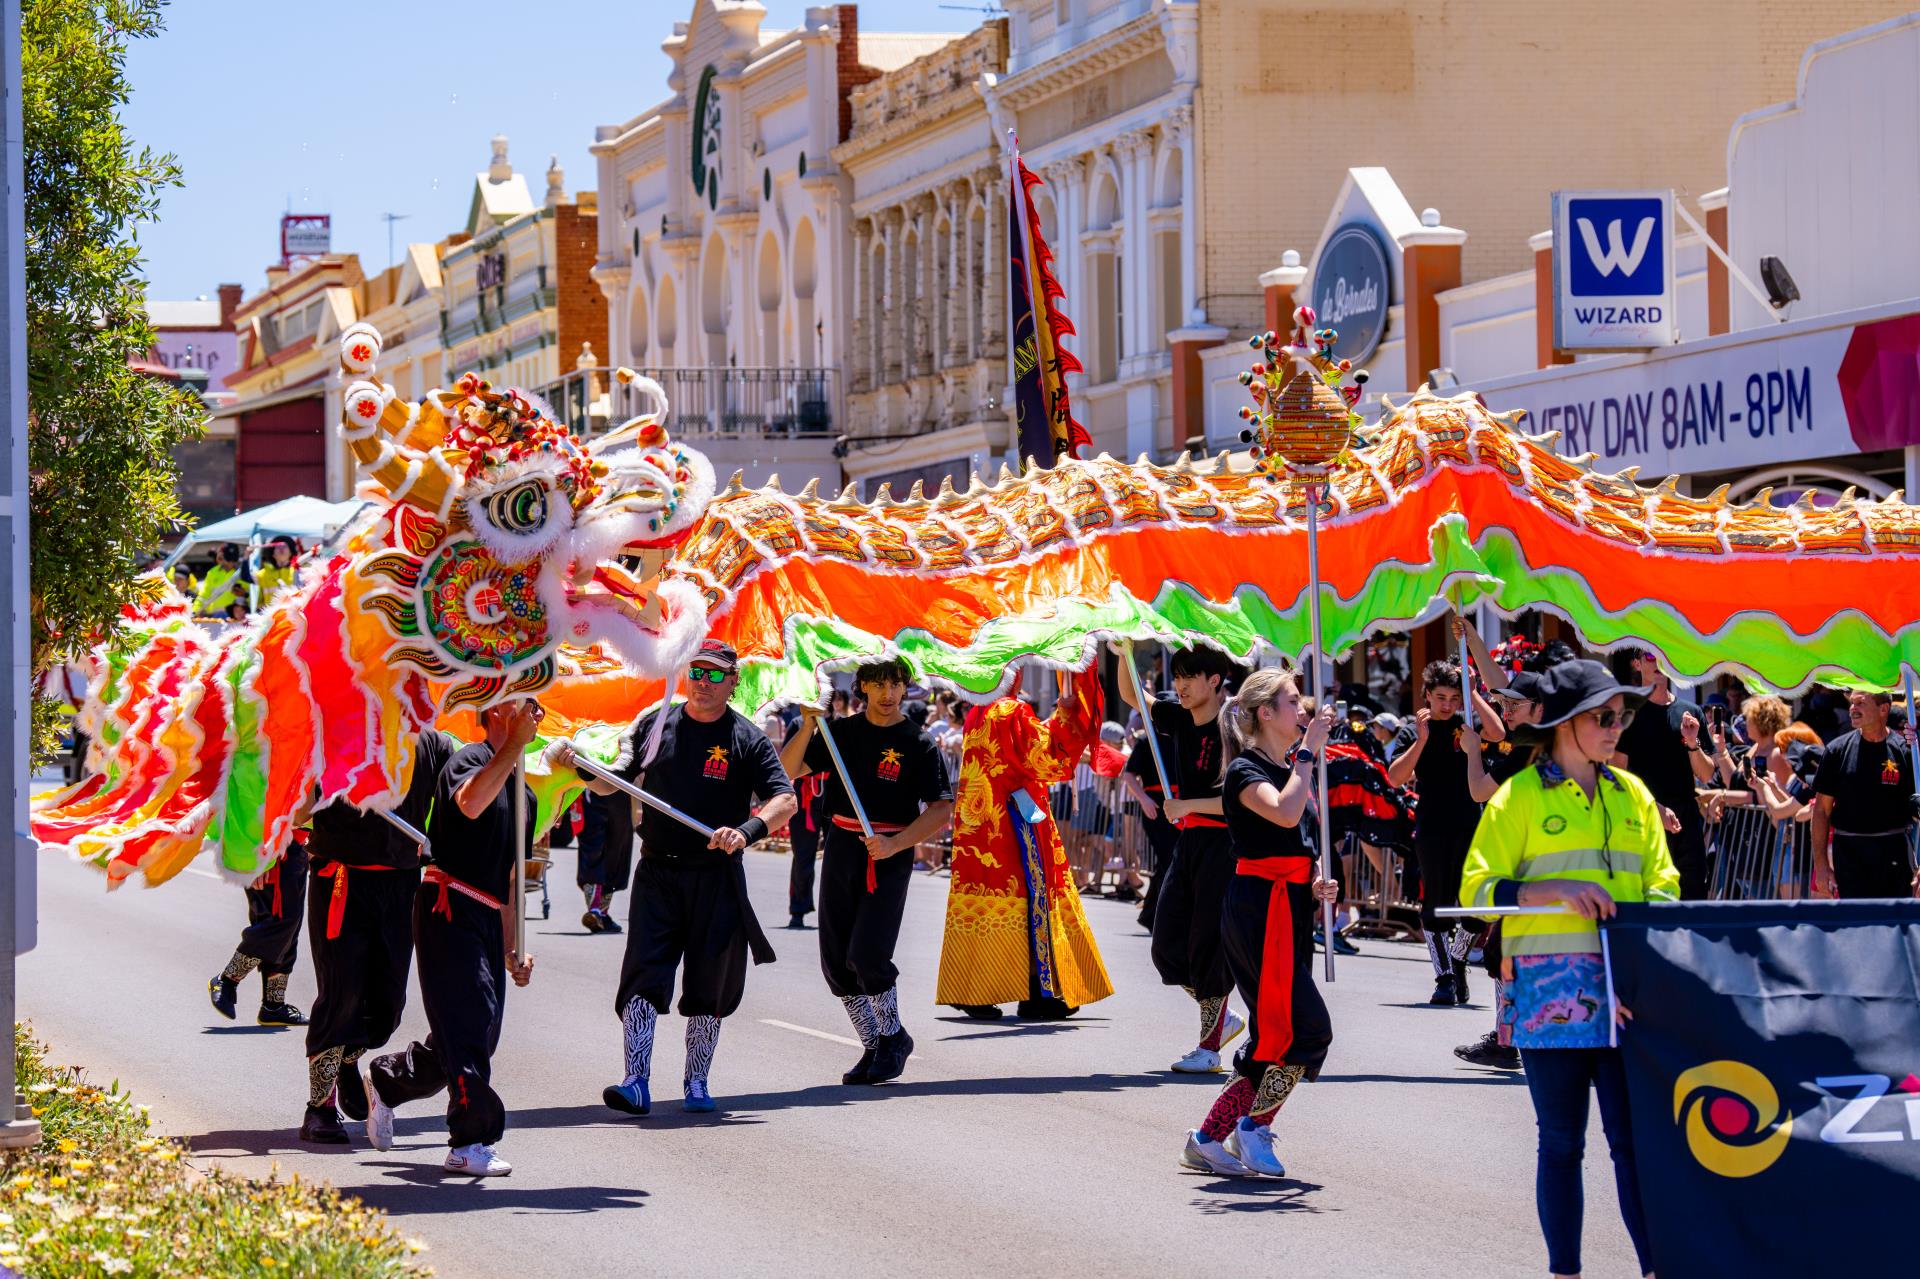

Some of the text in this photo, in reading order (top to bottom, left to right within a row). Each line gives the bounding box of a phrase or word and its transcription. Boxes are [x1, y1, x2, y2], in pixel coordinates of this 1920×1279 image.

[1576, 217, 1656, 278] W
[1574, 307, 1662, 325] WIZARD
[1603, 391, 1653, 457] DAY
